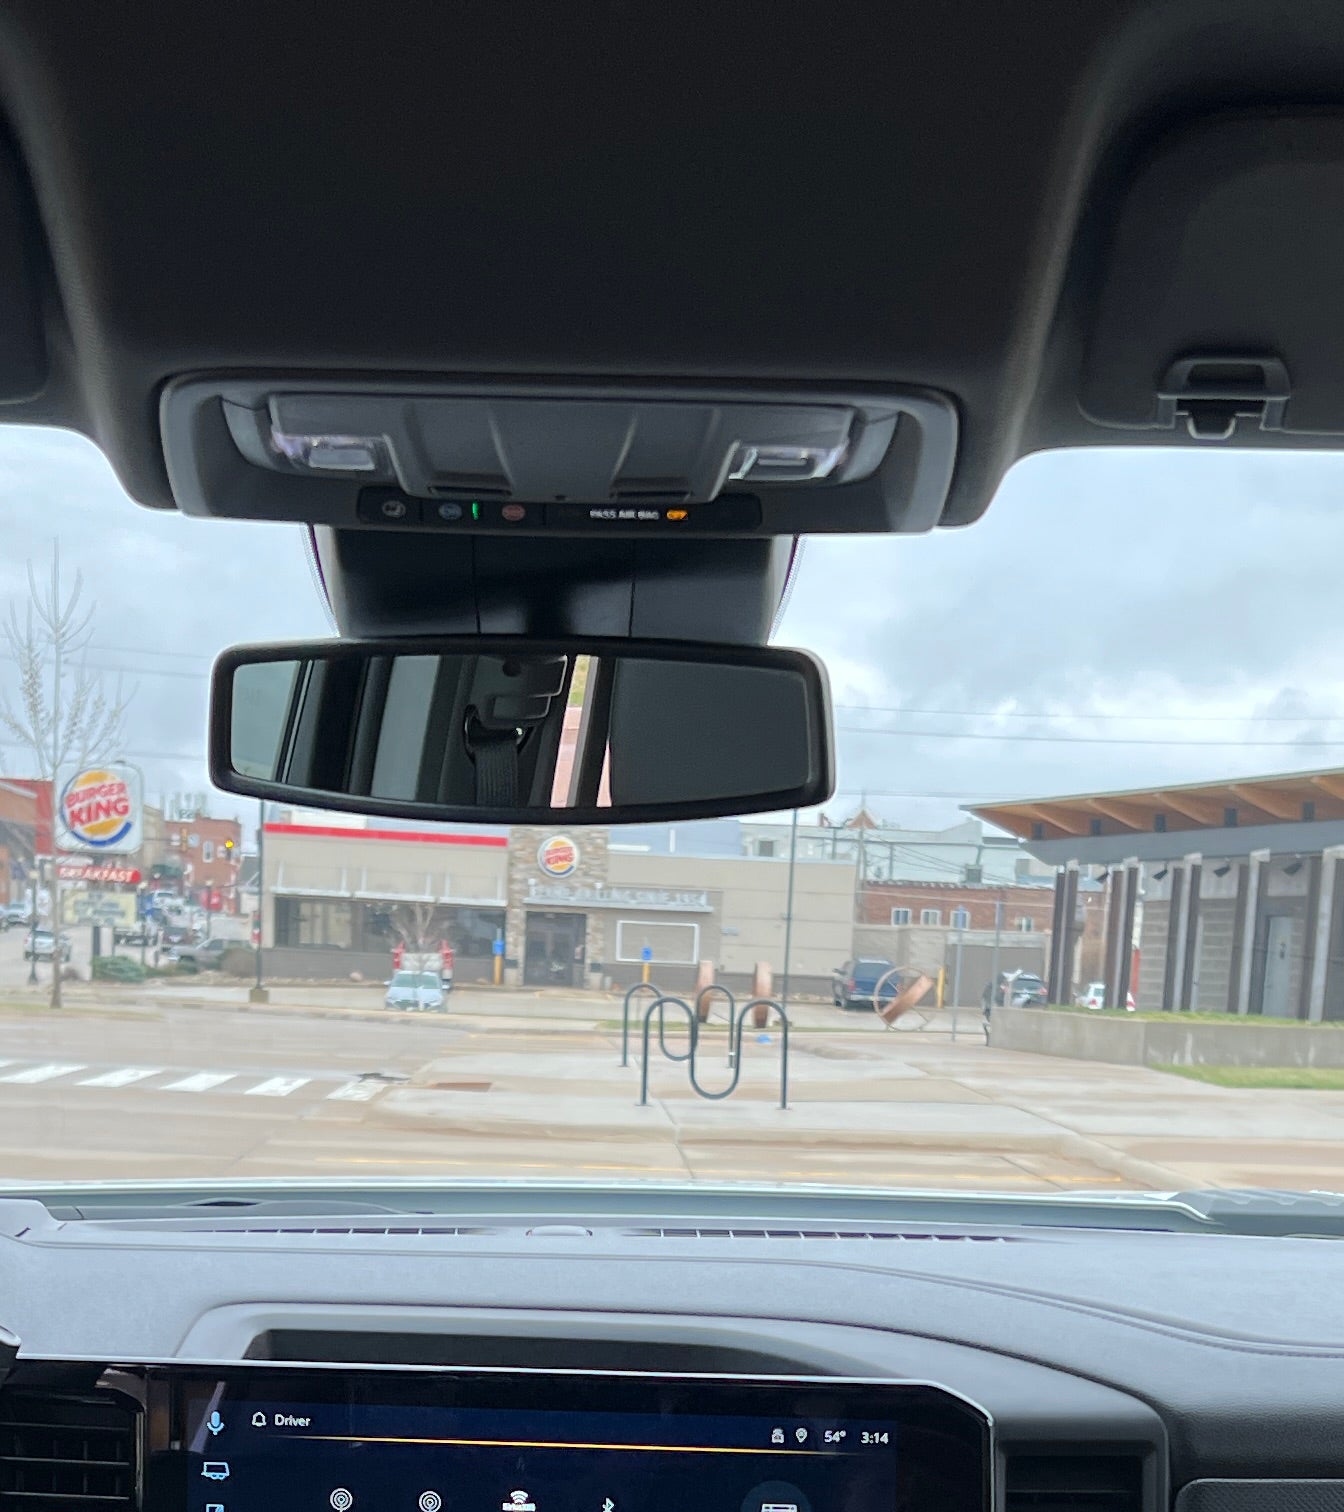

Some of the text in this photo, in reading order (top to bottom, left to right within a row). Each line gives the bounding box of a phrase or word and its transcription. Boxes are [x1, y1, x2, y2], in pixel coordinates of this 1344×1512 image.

[589, 509, 617, 519] PASS
[618, 509, 636, 519] AIR
[65, 782, 126, 808] BURGER
[69, 797, 130, 829] KING
[545, 854, 574, 865] KING
[58, 866, 134, 883] BREAKFAST
[274, 1414, 311, 1428] Driver
[824, 1430, 846, 1443] 54°
[860, 1431, 889, 1444] 3:14
